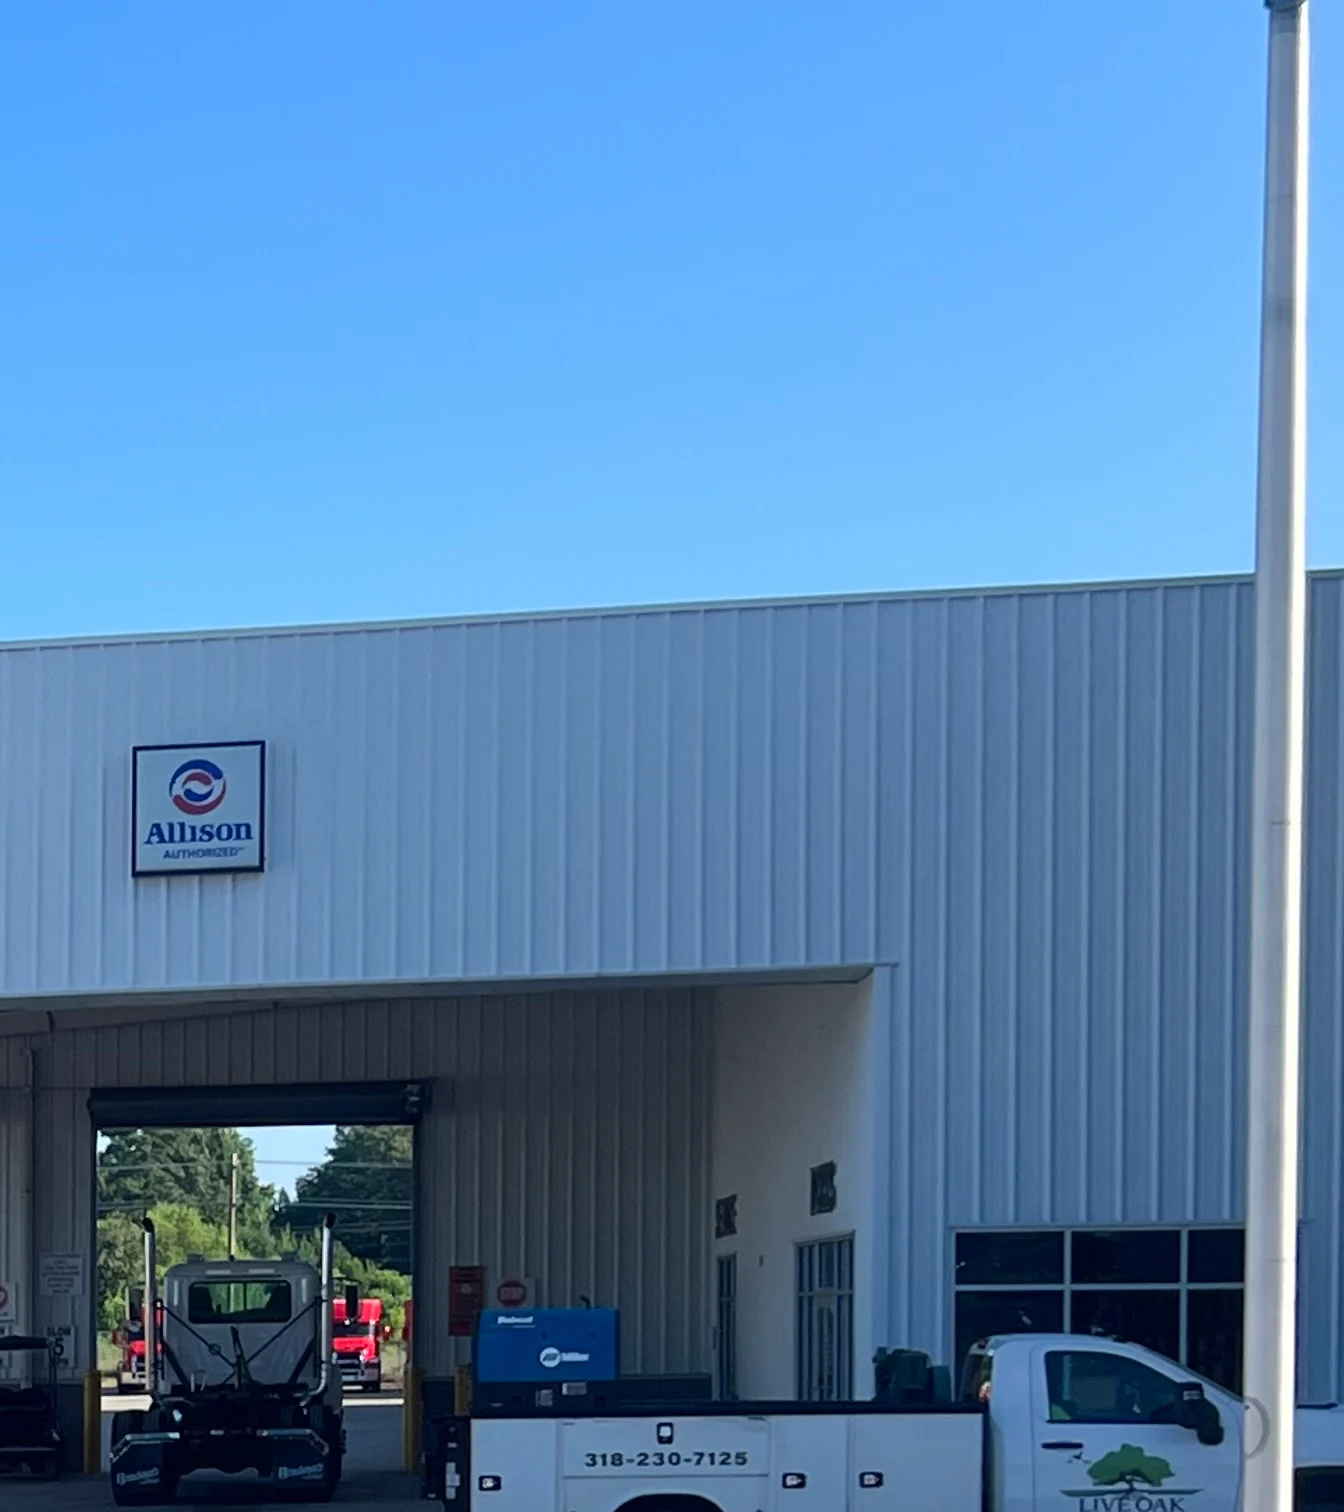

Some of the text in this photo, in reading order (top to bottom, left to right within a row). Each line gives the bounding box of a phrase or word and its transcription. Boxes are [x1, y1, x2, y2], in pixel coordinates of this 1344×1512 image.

[143, 821, 253, 845] Allison
[584, 1452, 748, 1467] 318-230-7125
[1078, 1497, 1185, 1512] LIVE OAK
